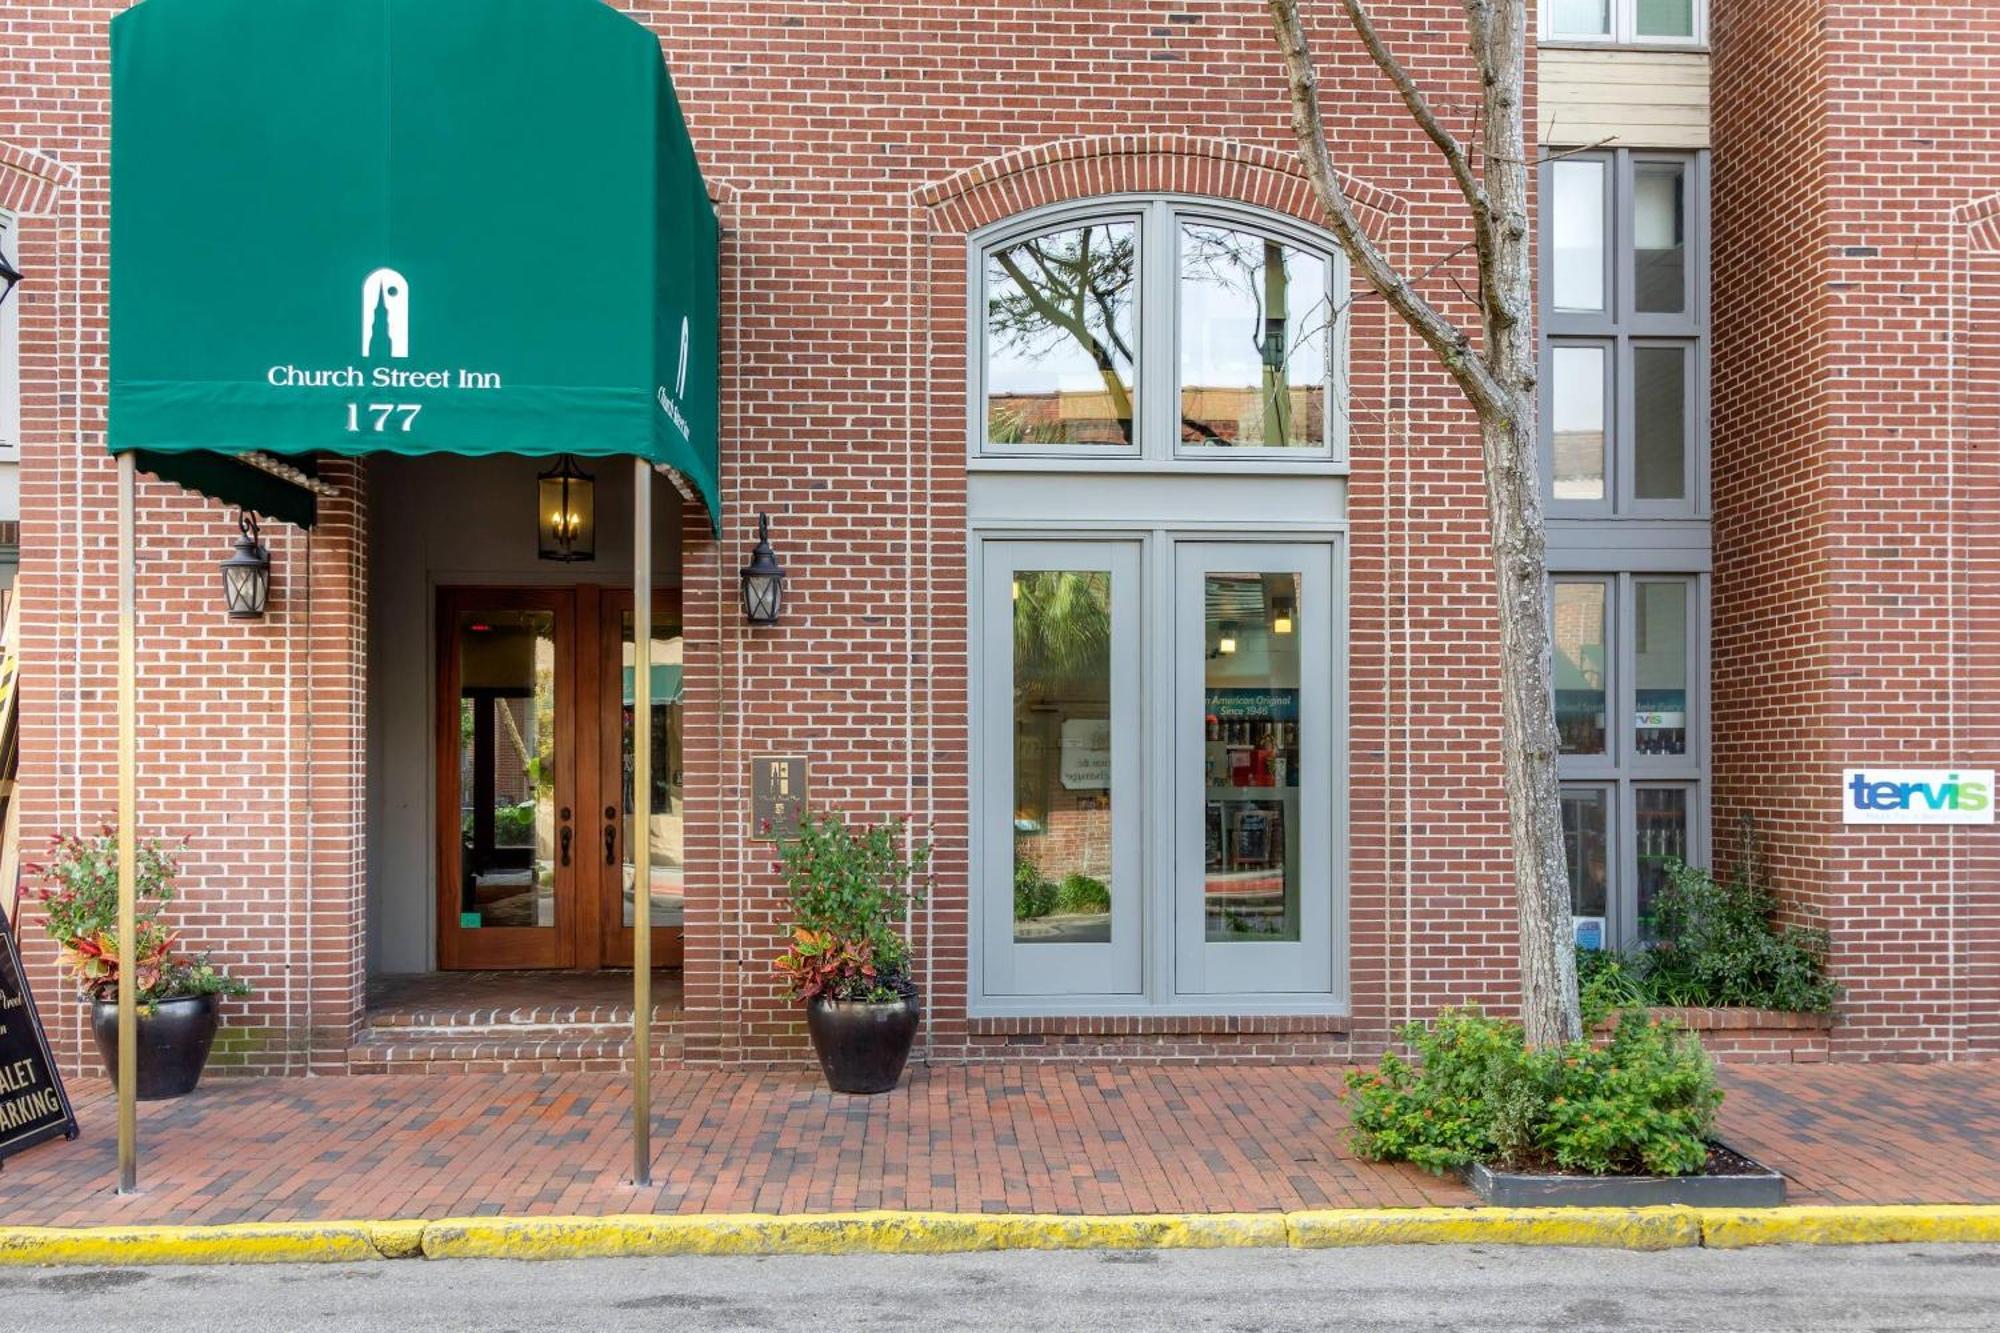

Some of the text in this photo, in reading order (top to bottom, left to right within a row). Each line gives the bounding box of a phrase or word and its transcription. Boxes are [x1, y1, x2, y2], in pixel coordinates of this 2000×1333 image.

[267, 365, 501, 389] Church Street Inn
[346, 403, 422, 432] 177
[1211, 695, 1254, 705] American
[1255, 695, 1292, 708] Original
[1220, 705, 1244, 716] Since
[1848, 773, 1989, 811] tervis
[0, 1058, 36, 1095] ALET
[0, 1087, 60, 1133] ARKING
